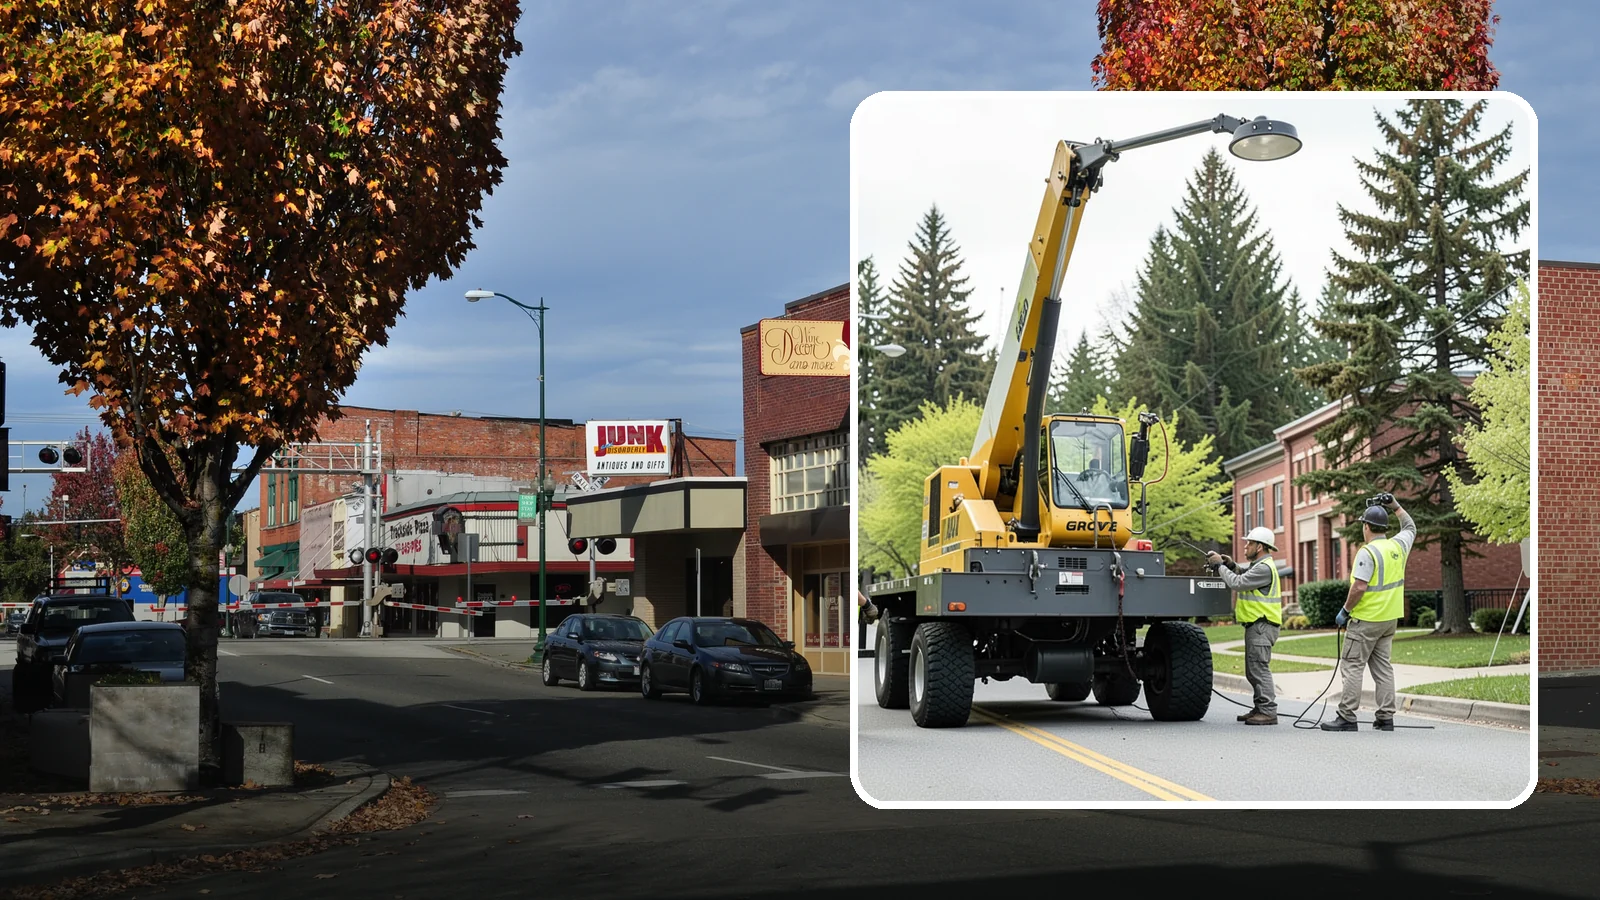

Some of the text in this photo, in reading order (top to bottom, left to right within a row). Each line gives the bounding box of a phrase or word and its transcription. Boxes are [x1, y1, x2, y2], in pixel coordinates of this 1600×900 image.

[595, 425, 665, 457] JUNK
[607, 446, 646, 454] DISORDERLY
[596, 460, 665, 470] ANTIQUES AND GIFTS
[415, 519, 429, 535] Pizza
[1066, 520, 1118, 532] GROVE
